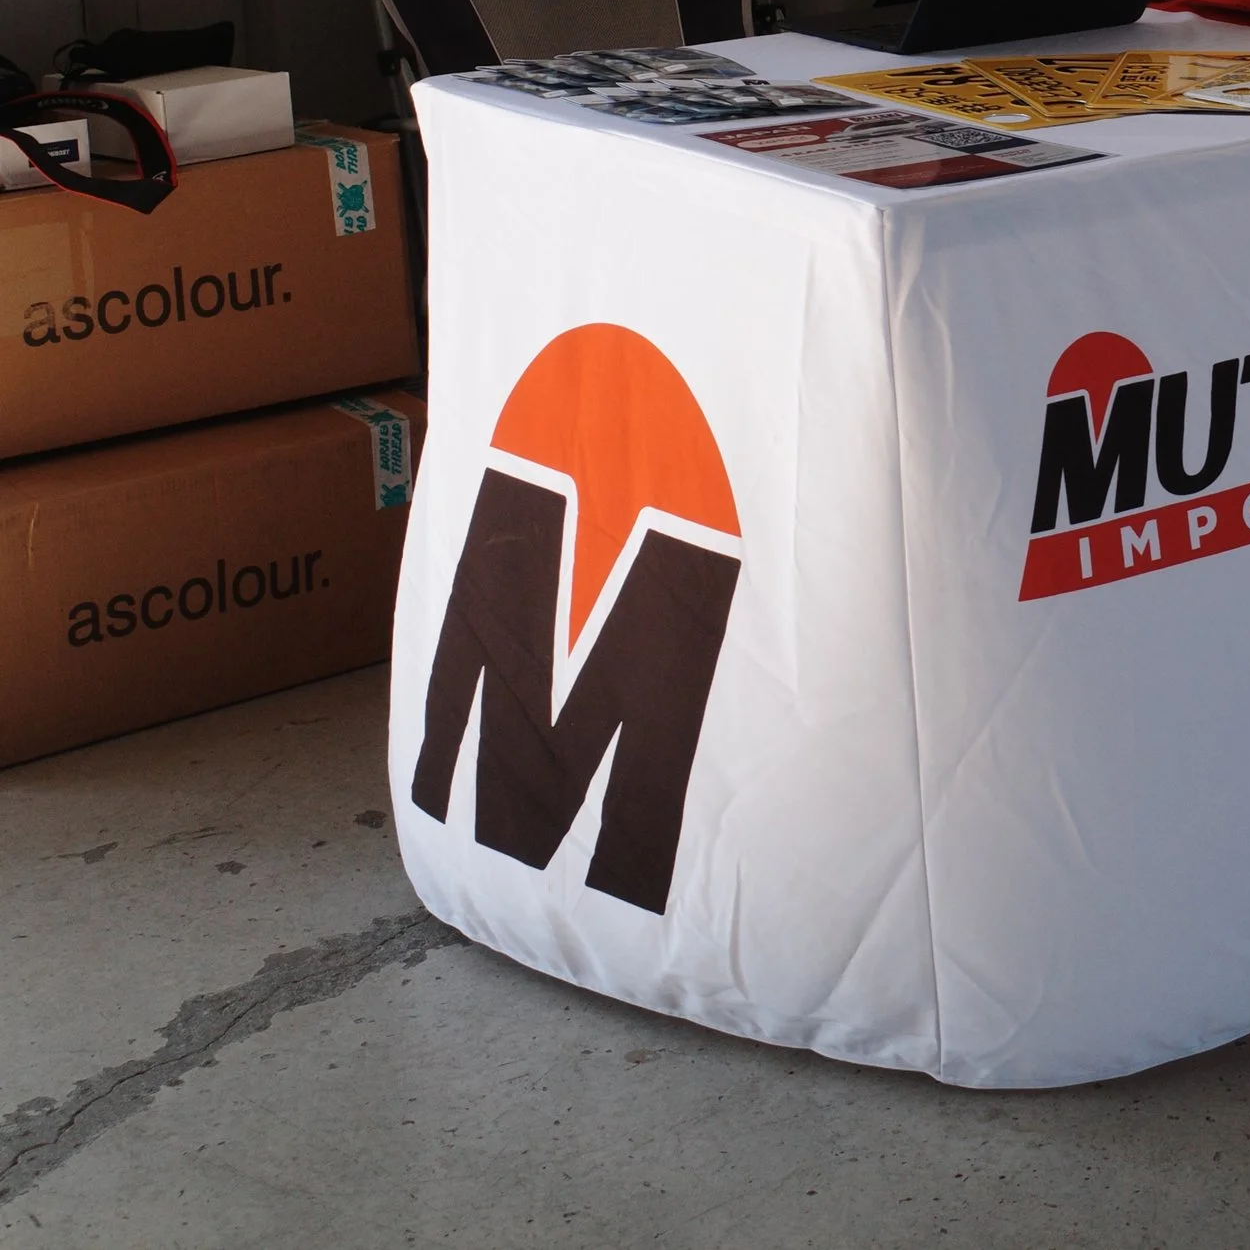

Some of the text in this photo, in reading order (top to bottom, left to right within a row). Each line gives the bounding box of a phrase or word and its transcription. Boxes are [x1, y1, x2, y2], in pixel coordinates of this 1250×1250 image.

[22, 262, 293, 347] ascolour.
[390, 423, 402, 475] THREAD
[66, 549, 331, 648] ascolour.
[411, 467, 741, 916] M
